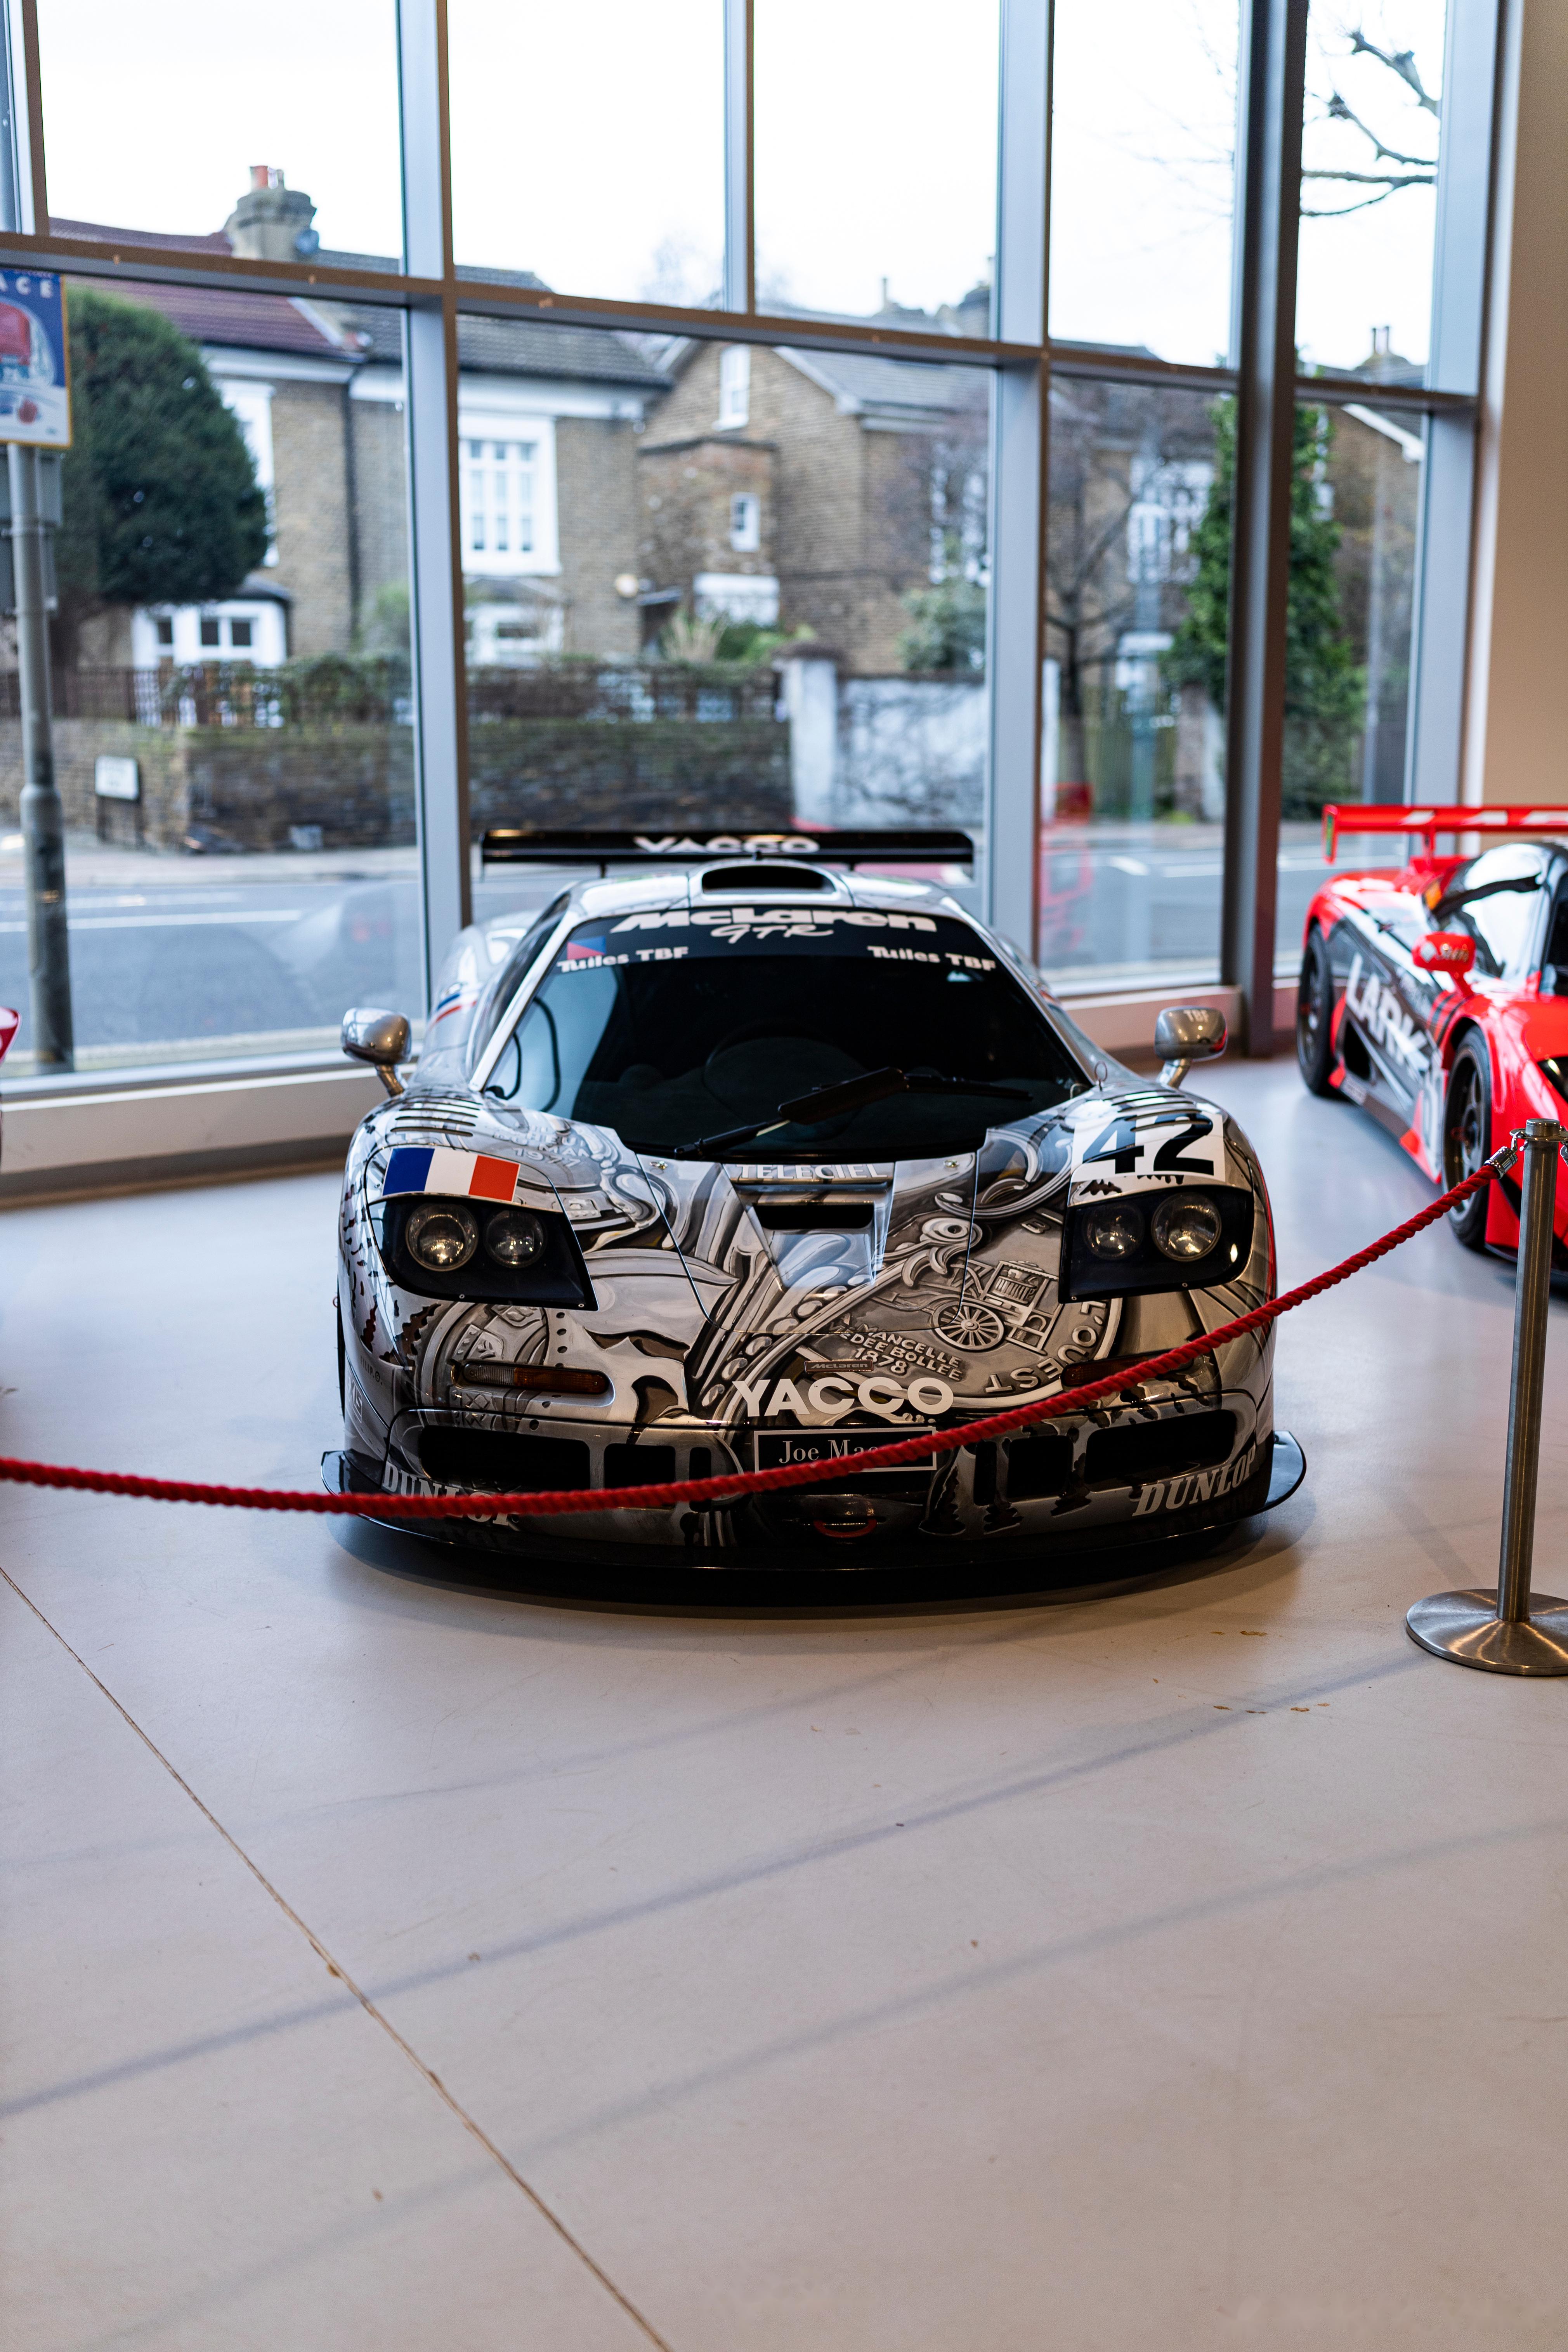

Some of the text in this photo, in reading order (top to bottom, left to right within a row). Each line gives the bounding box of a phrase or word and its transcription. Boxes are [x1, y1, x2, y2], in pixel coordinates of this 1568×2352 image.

[610, 908, 937, 933] McLaren
[710, 924, 834, 944] GTR
[557, 946, 689, 973] Tuiles TBF
[867, 946, 996, 971] Tuiles TBF
[513, 1148, 581, 1167] 1977
[1082, 1113, 1214, 1176] 42
[737, 1164, 888, 1179] TELECIEL
[855, 1347, 907, 1375] 1878
[890, 1346, 963, 1382] BOLLEE
[732, 1376, 954, 1417] YACCO
[779, 1441, 819, 1463] Joe
[1132, 1441, 1256, 1516] DUNLOP
[382, 1461, 509, 1526] DUNO
